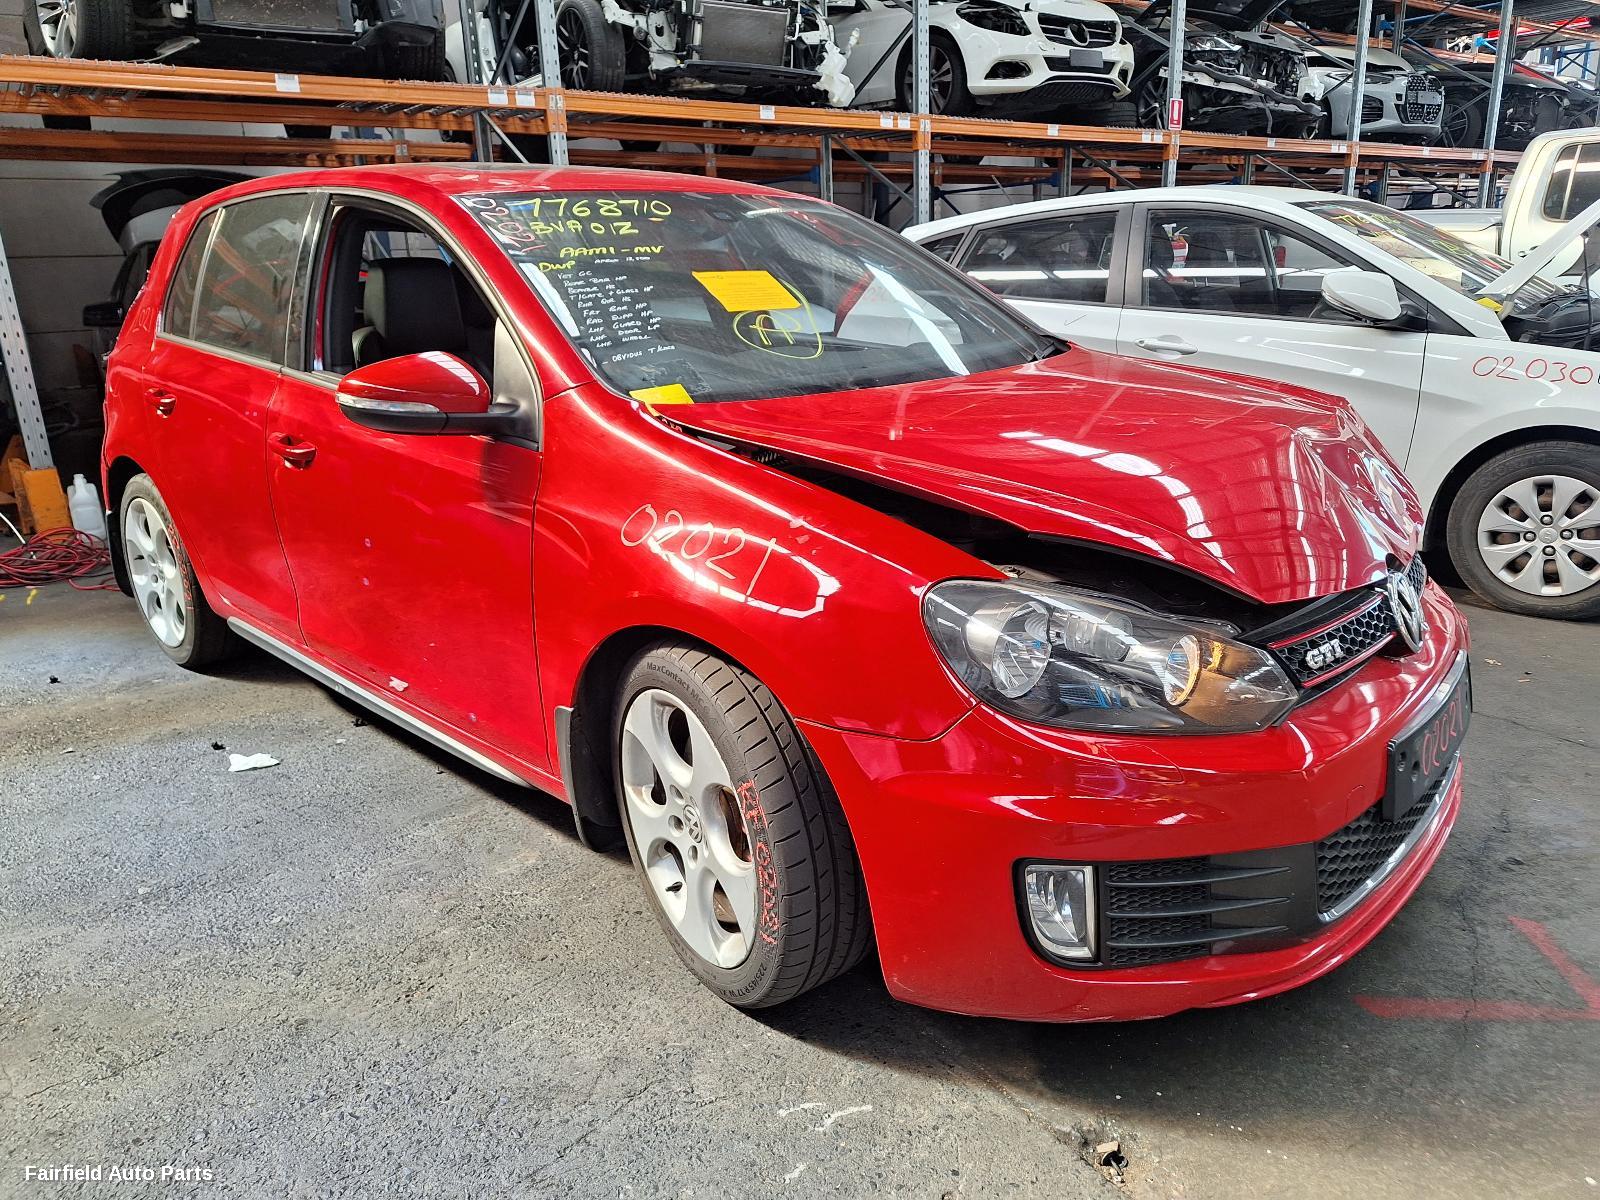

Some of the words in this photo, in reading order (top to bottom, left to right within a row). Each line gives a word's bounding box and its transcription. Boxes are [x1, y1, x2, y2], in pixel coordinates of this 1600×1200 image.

[504, 198, 672, 217] 7768710
[559, 246, 616, 258] AAMI
[586, 317, 604, 326] RAD
[612, 320, 642, 330] GUARD
[611, 350, 643, 362] OBVIOUS
[1472, 356, 1593, 385] 02030
[1305, 639, 1344, 669] GTI
[646, 661, 691, 691] MaxContact
